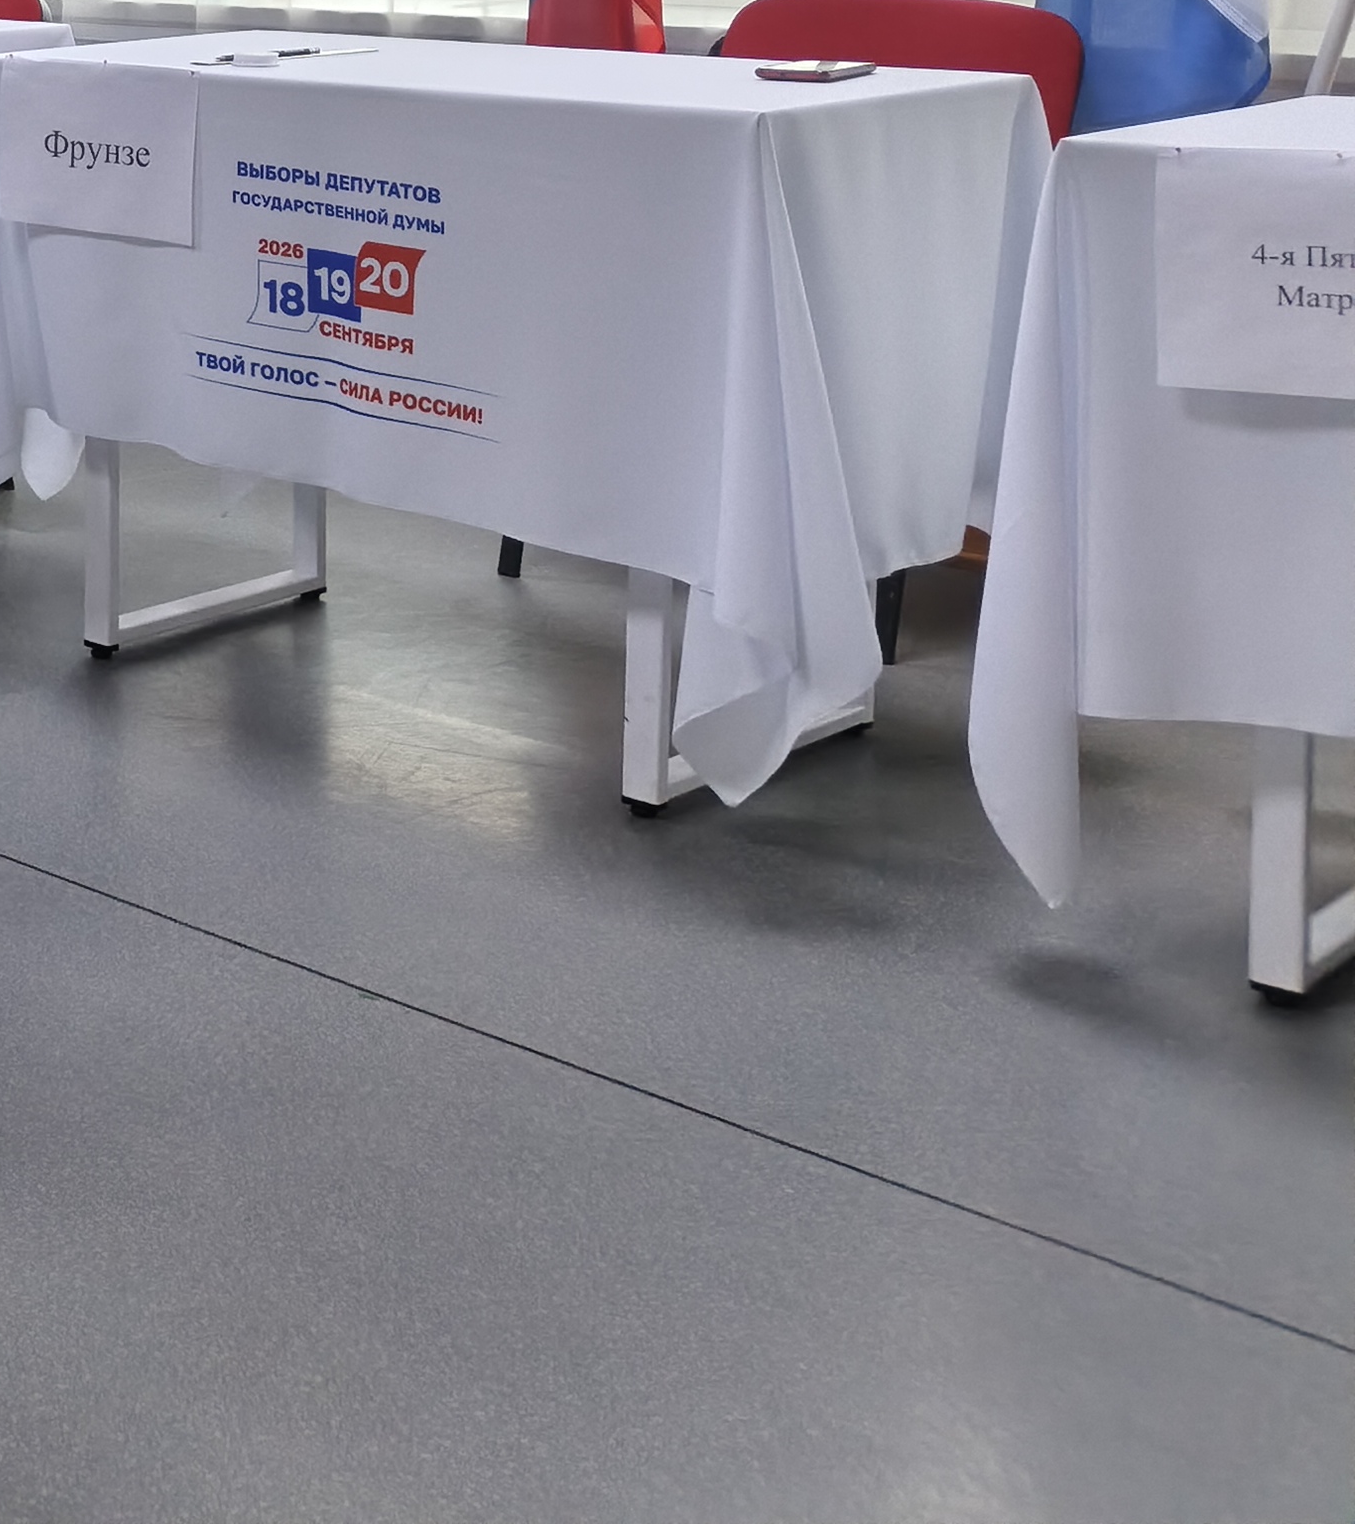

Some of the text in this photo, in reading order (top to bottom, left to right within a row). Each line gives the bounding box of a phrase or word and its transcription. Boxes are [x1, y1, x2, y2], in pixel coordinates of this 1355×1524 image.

[44, 130, 151, 169] Фрунзе
[237, 161, 441, 204] ВЫБОРЫ ДЕПУТАТОВ
[232, 190, 445, 234] ГОСУДАРСТВЕННОЙ ДУМЫ
[258, 238, 304, 259] 2026
[1251, 244, 1295, 266] 4-я
[263, 257, 409, 317] 18 19 20
[1277, 285, 1355, 315] Матр
[319, 320, 414, 355] СЕНТЯБРЯ
[196, 350, 245, 375] ТВОЙ
[250, 362, 320, 388] ГОЛОС
[340, 378, 383, 405] СИЛА
[389, 390, 483, 425] РОССИИ!
